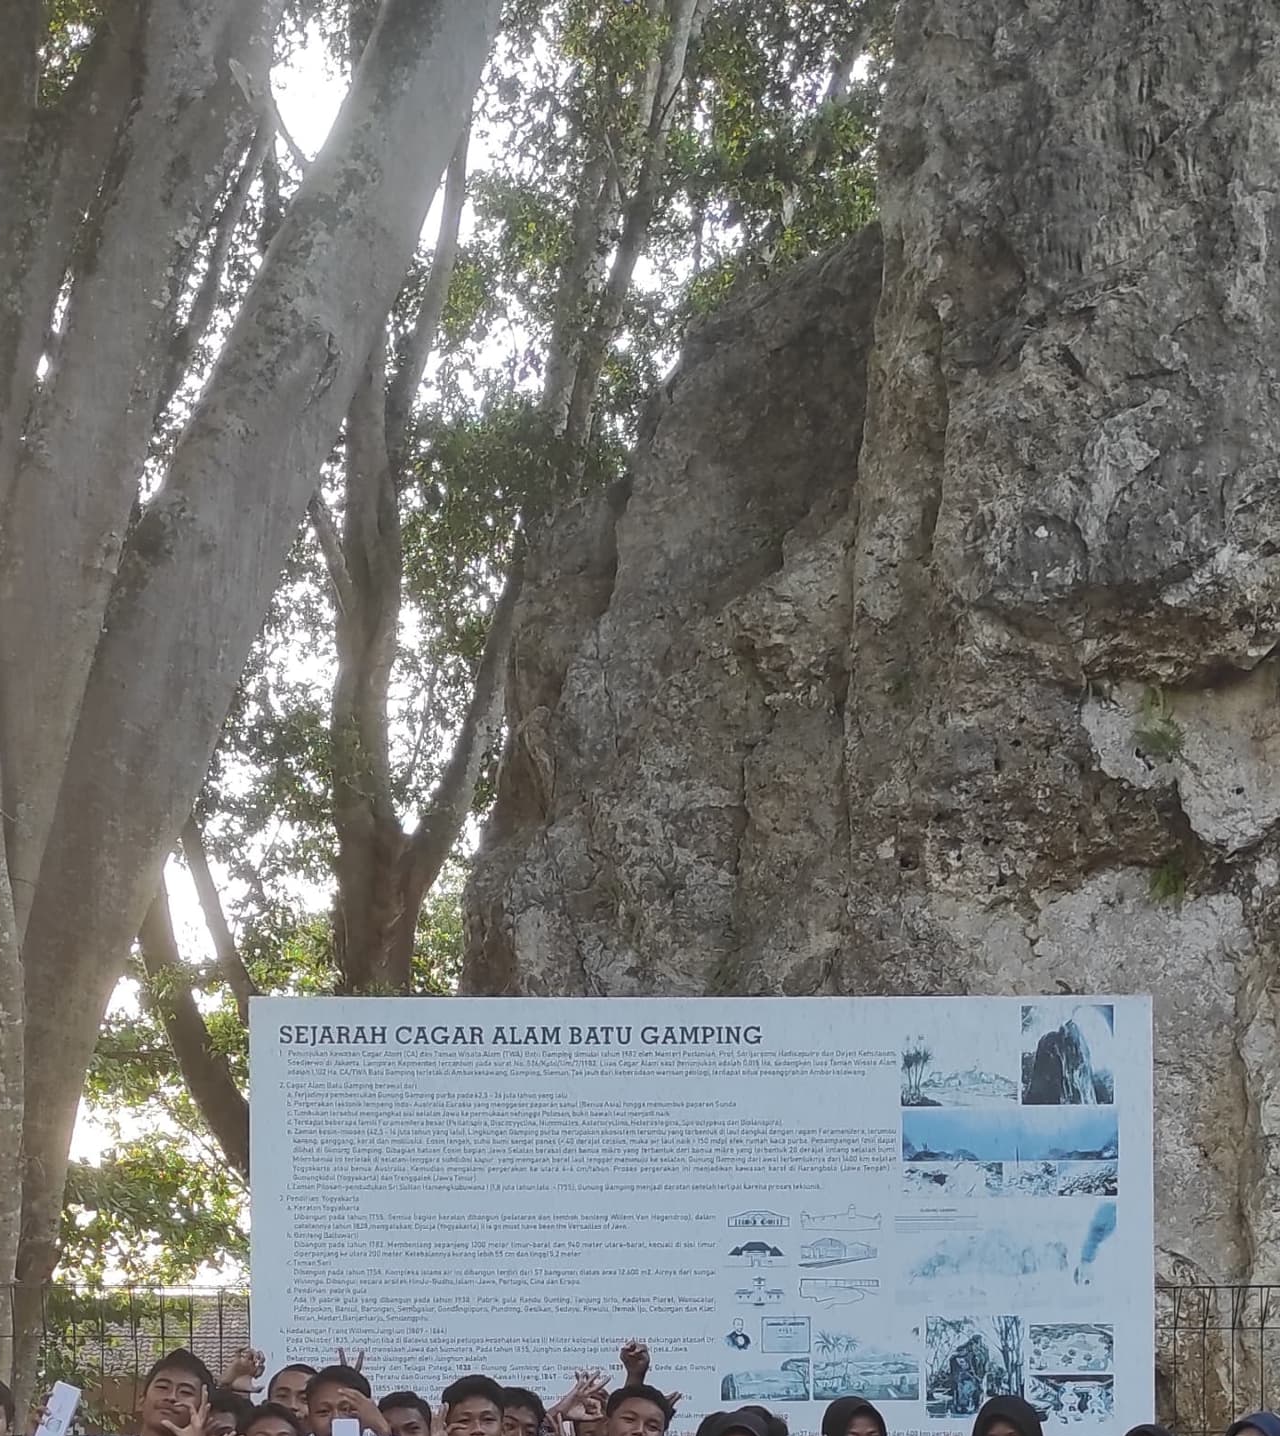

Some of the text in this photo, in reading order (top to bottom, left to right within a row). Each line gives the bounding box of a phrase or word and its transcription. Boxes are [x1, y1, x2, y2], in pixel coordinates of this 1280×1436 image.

[279, 1026, 762, 1046] SEJARAH CAGAR ALAM BATU GAMPING
